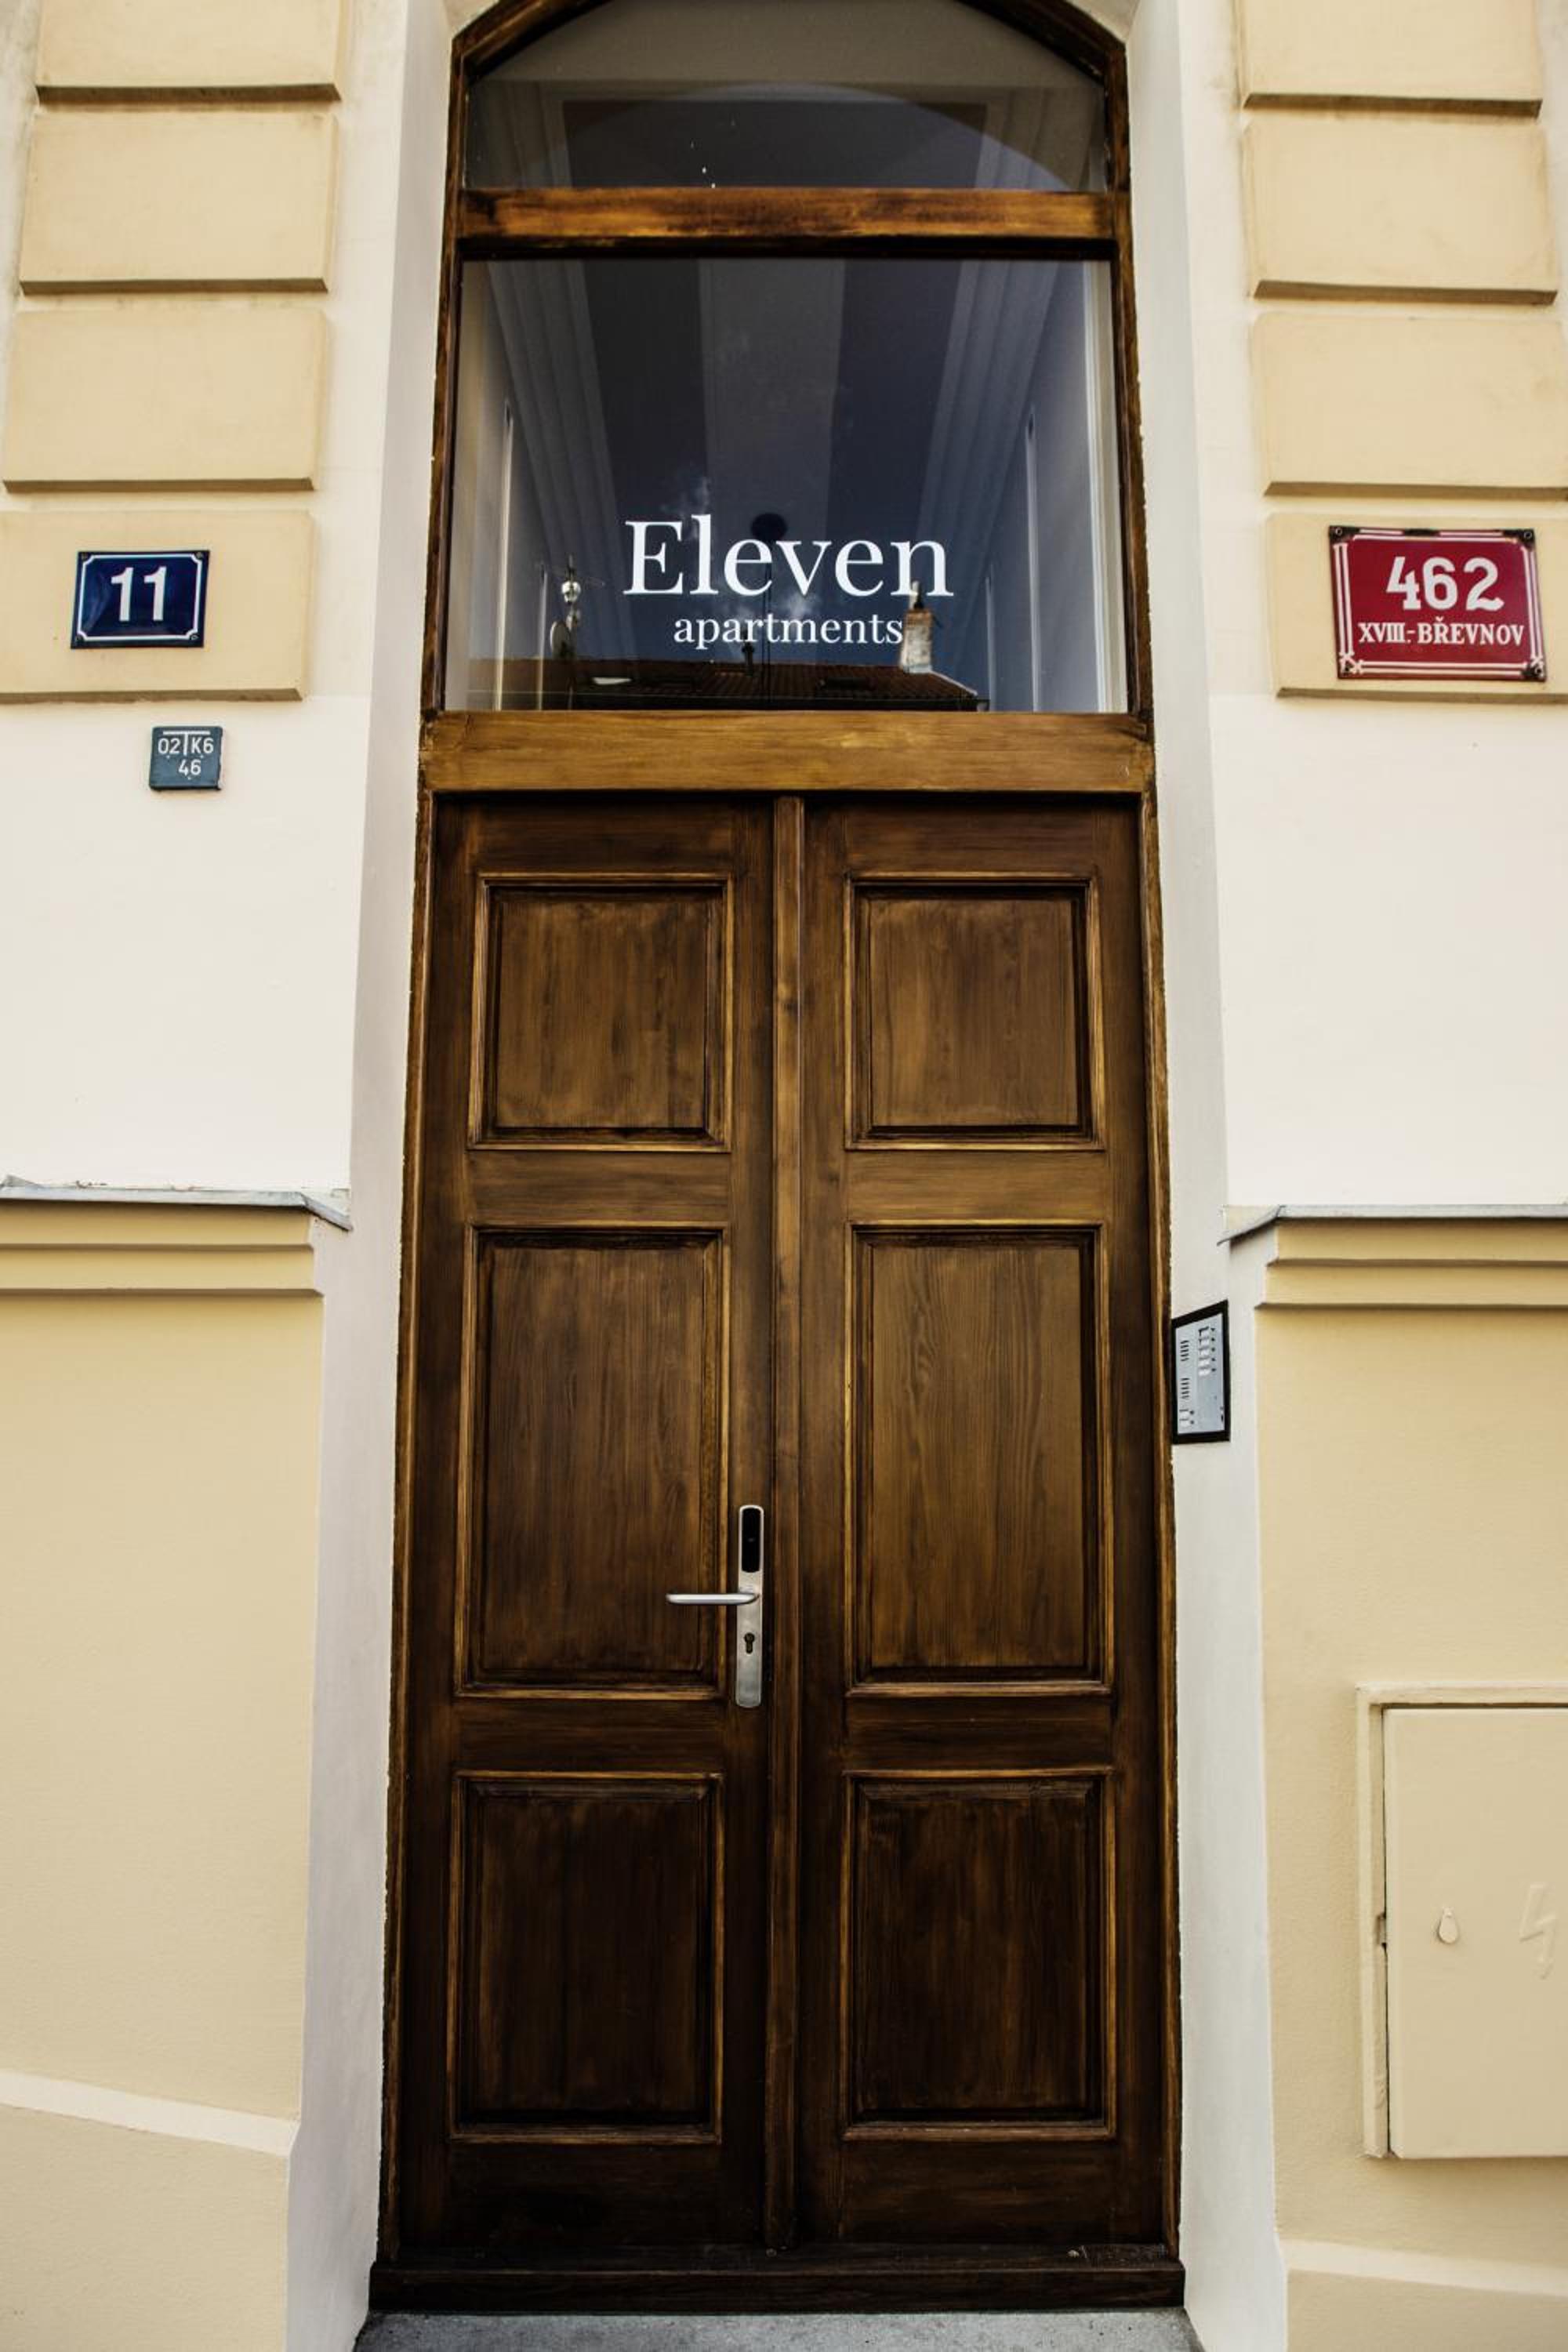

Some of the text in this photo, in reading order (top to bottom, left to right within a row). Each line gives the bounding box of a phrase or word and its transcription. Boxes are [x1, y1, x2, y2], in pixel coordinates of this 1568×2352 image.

[622, 514, 954, 597] Eleven
[111, 566, 167, 622] 11
[1385, 556, 1505, 612] 462
[673, 613, 903, 650] apartments
[178, 759, 201, 776] 46
